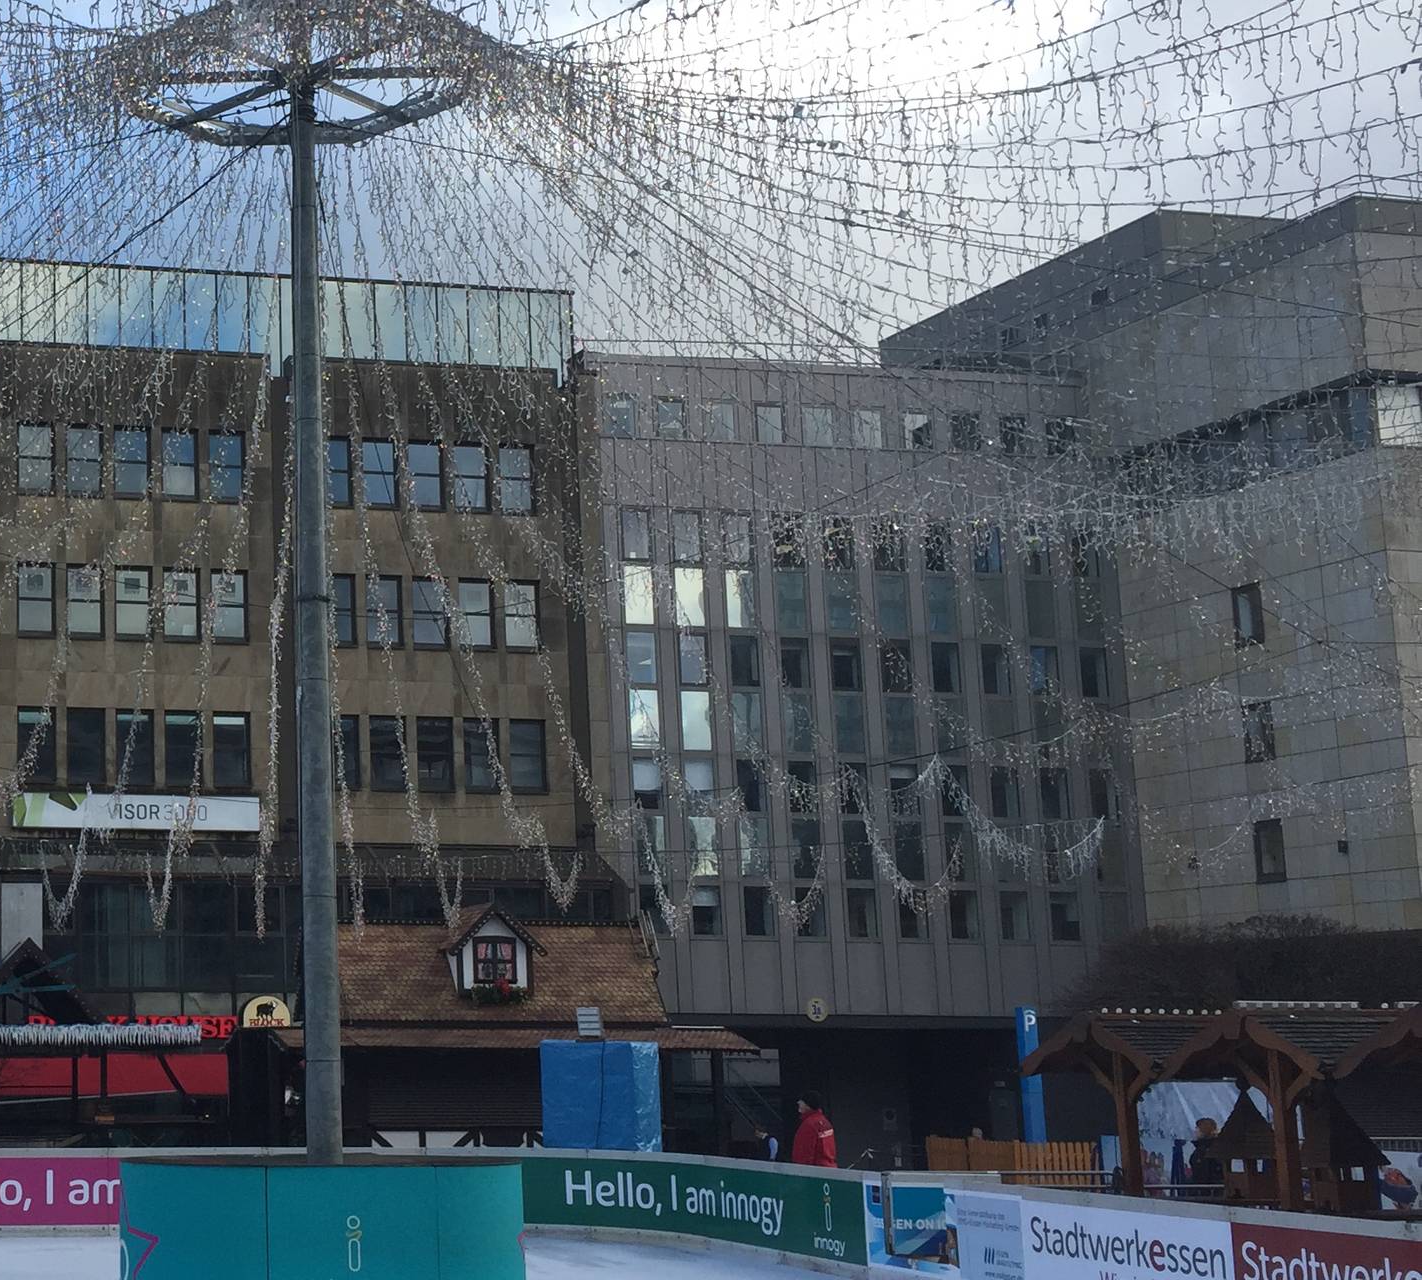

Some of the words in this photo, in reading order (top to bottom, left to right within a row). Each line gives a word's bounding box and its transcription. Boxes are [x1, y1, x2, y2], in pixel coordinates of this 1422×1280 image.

[1024, 1014, 1037, 1032] P
[45, 1169, 55, 1206] I
[564, 1169, 663, 1217] Hello,
[670, 1174, 678, 1212] I
[685, 1185, 716, 1218] am
[720, 1180, 784, 1236] innogy
[813, 1232, 846, 1257] innogy
[1029, 1215, 1226, 1279] Stadtwerkessen
